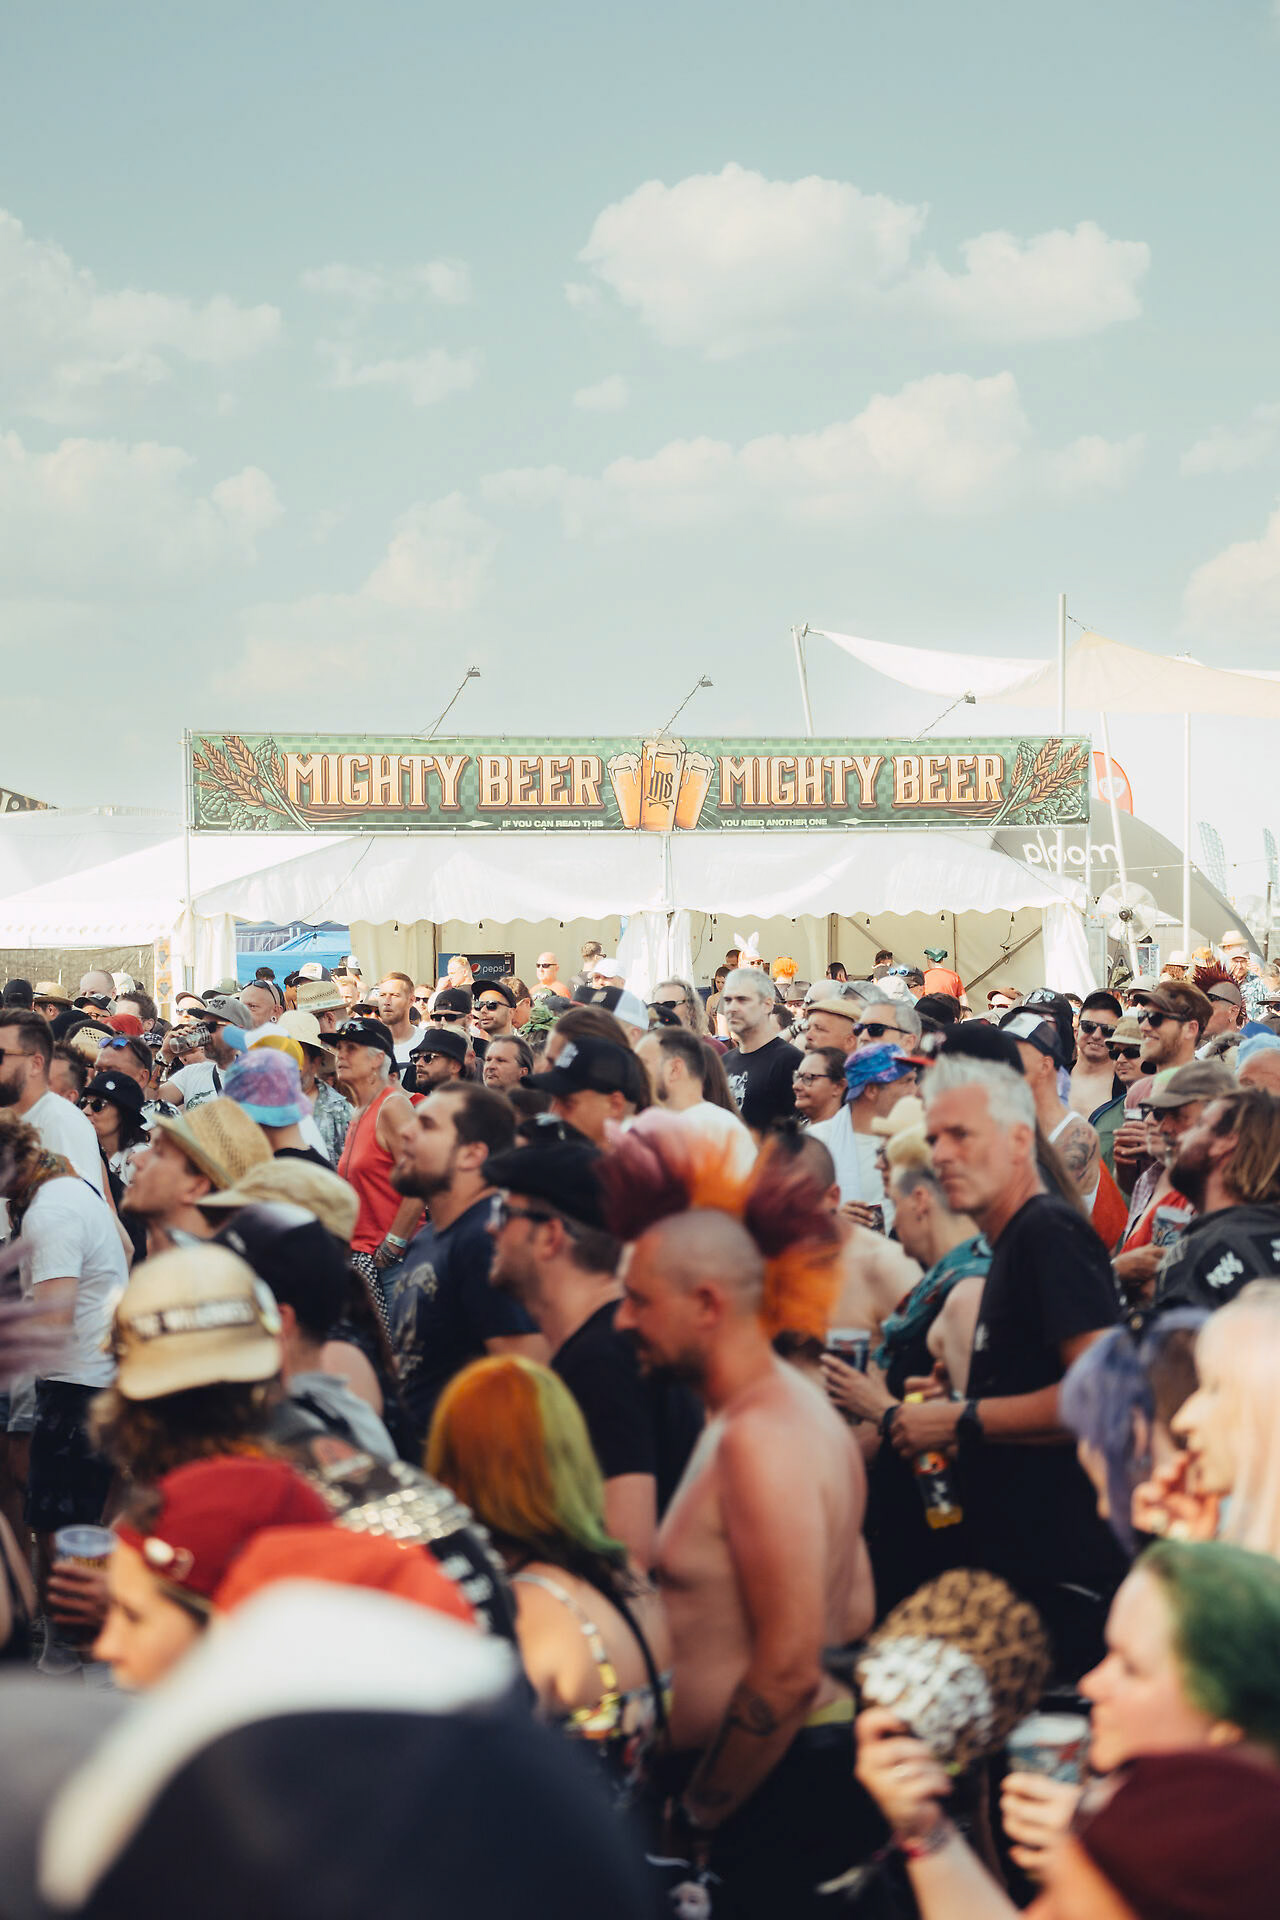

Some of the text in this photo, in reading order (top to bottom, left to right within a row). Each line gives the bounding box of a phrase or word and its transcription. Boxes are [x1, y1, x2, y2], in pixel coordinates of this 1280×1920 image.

[281, 753, 605, 810] MIGHTY BEER
[716, 754, 1006, 809] MIGHTY BEER
[502, 820, 605, 828] IF YOU CAN READ THIS
[720, 818, 828, 827] YOU NEED ANOTHER ONE
[482, 964, 505, 974] pepsi
